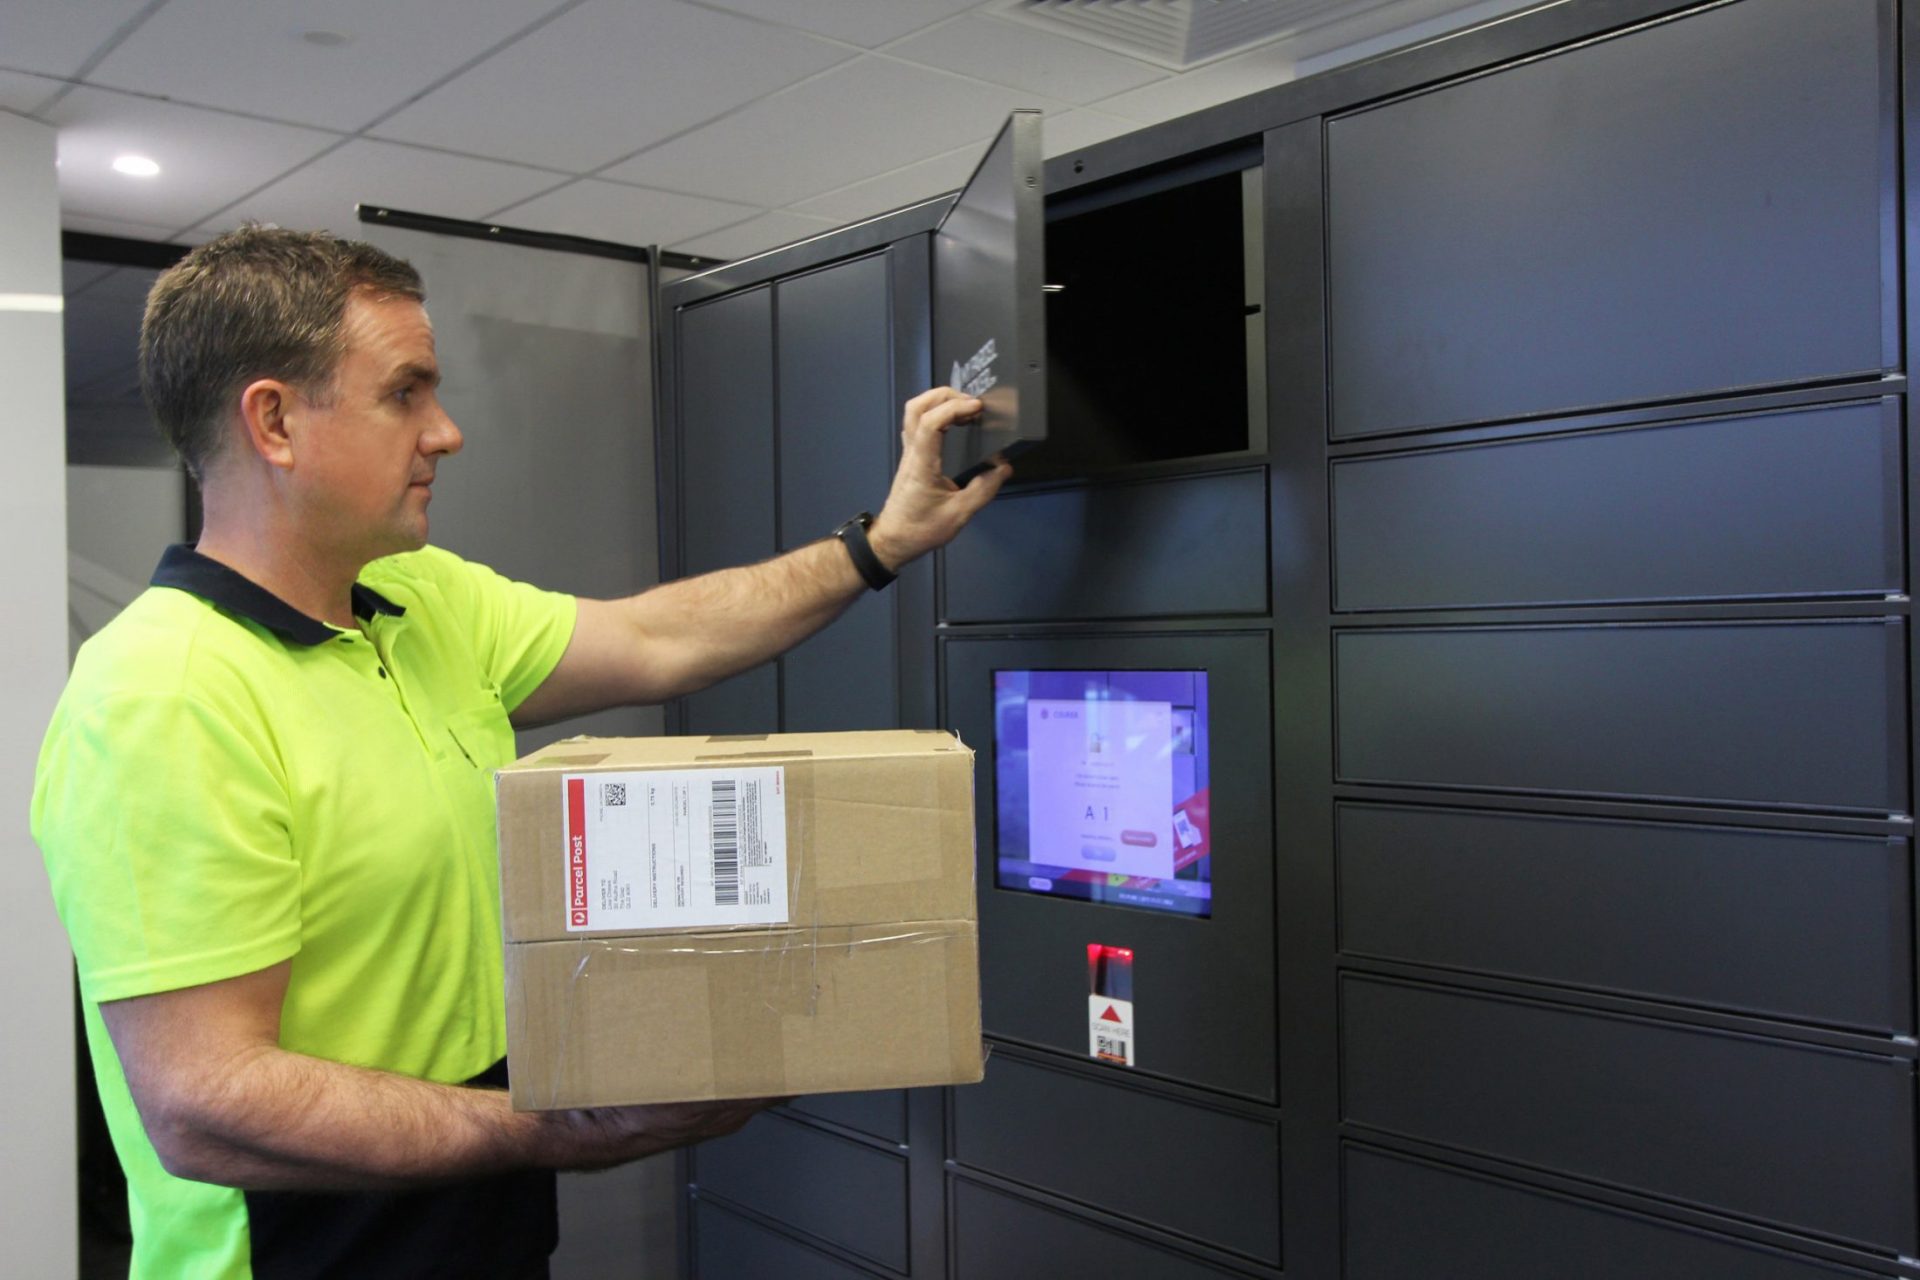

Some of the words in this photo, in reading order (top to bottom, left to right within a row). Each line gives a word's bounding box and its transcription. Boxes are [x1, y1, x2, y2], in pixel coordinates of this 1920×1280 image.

[1084, 806, 1094, 820] A
[572, 835, 583, 864] Post
[573, 867, 585, 906] Parcel
